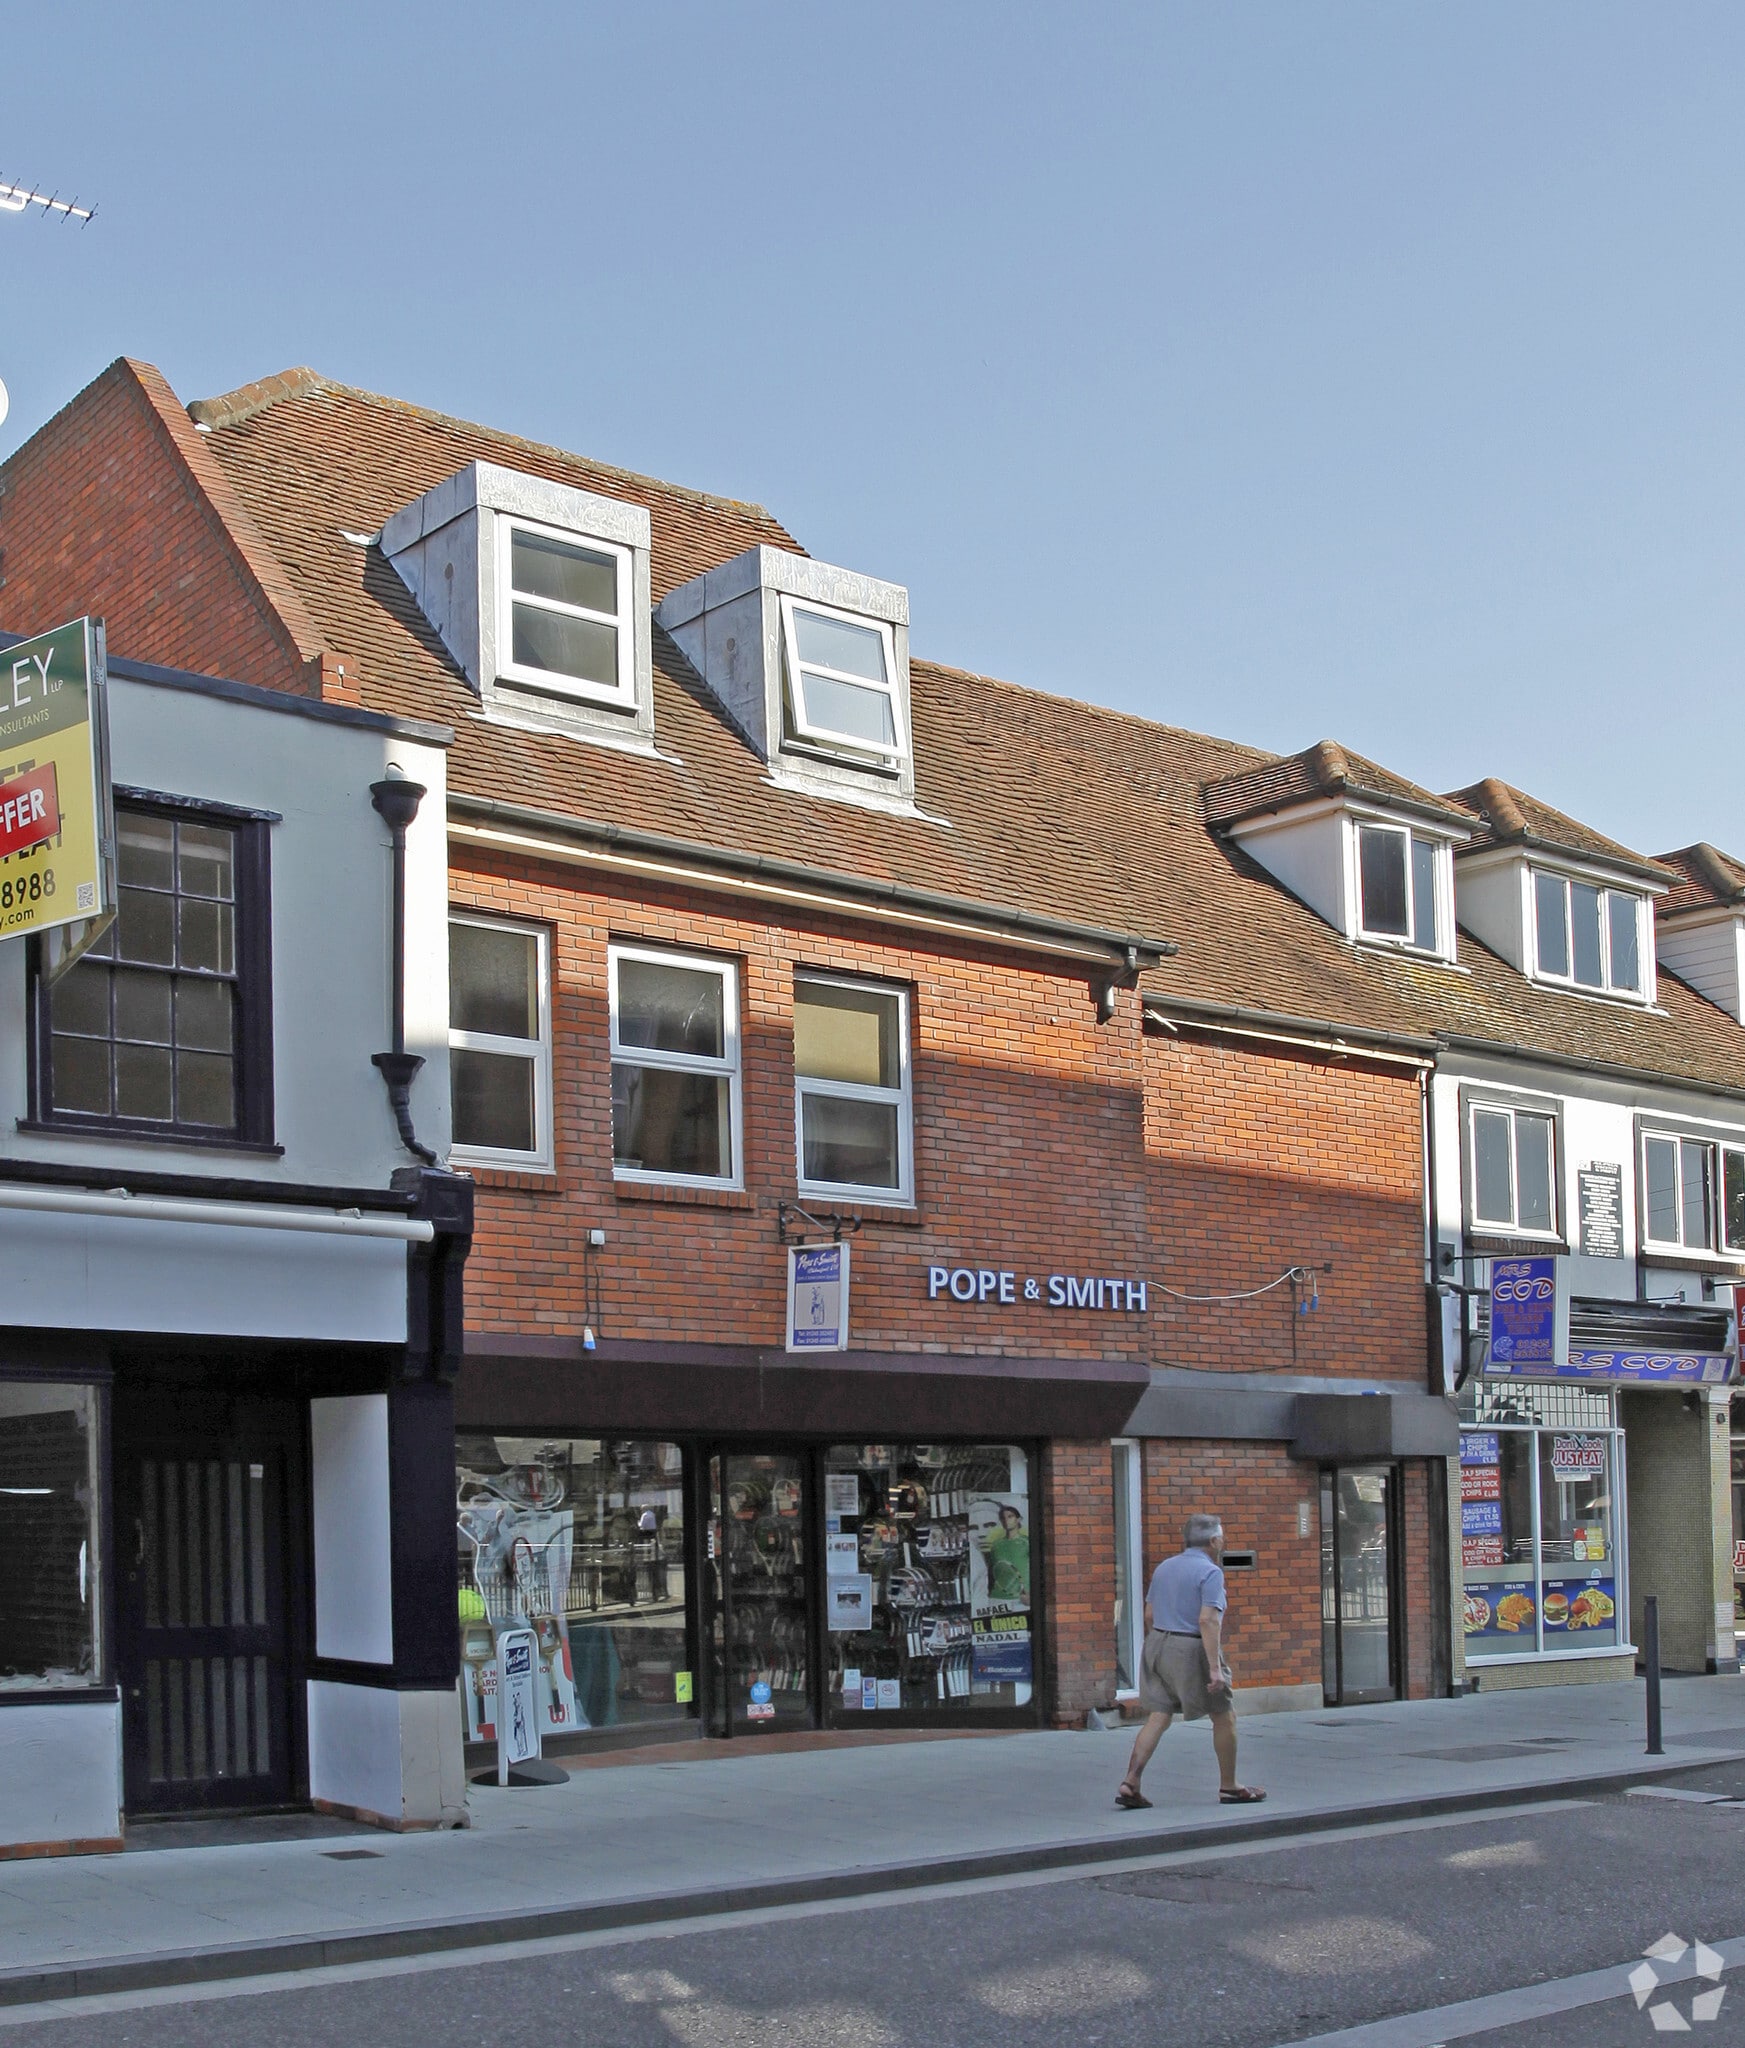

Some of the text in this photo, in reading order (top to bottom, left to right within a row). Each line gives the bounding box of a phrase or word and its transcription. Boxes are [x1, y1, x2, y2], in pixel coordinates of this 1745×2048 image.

[2, 868, 56, 909] 8988
[1494, 1263, 1532, 1278] MRS
[928, 1266, 1148, 1313] POPE & SMITH
[1494, 1277, 1554, 1301] COD
[1621, 1355, 1699, 1371] COD
[1582, 1439, 1603, 1449] cook
[1554, 1450, 1604, 1465] JUST EAT
[976, 1603, 1012, 1616] RAFAEL
[973, 1620, 987, 1633] EL
[976, 1632, 1021, 1643] NADAL
